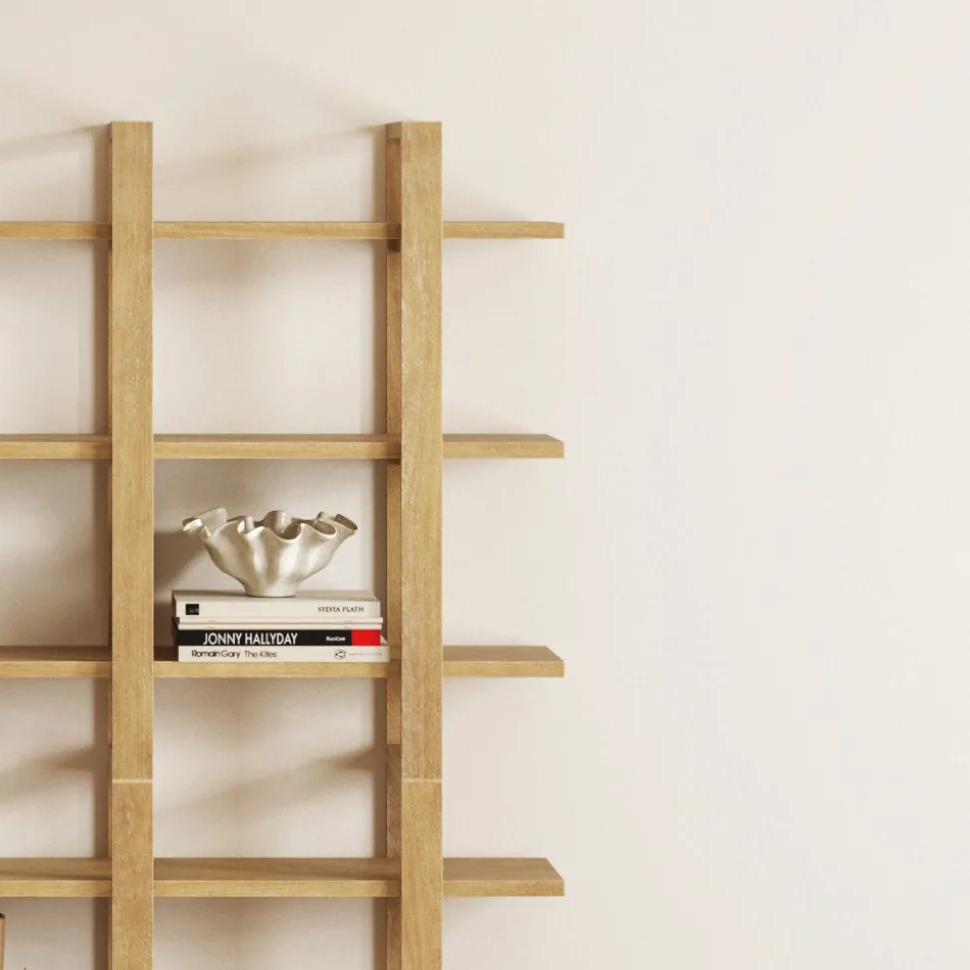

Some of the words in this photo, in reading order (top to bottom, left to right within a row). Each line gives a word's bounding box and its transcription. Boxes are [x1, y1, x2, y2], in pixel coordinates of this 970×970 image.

[203, 632, 243, 645] JONNY
[244, 632, 298, 645] HALLYDAY
[191, 650, 220, 658] Romain
[221, 650, 241, 659] Gary
